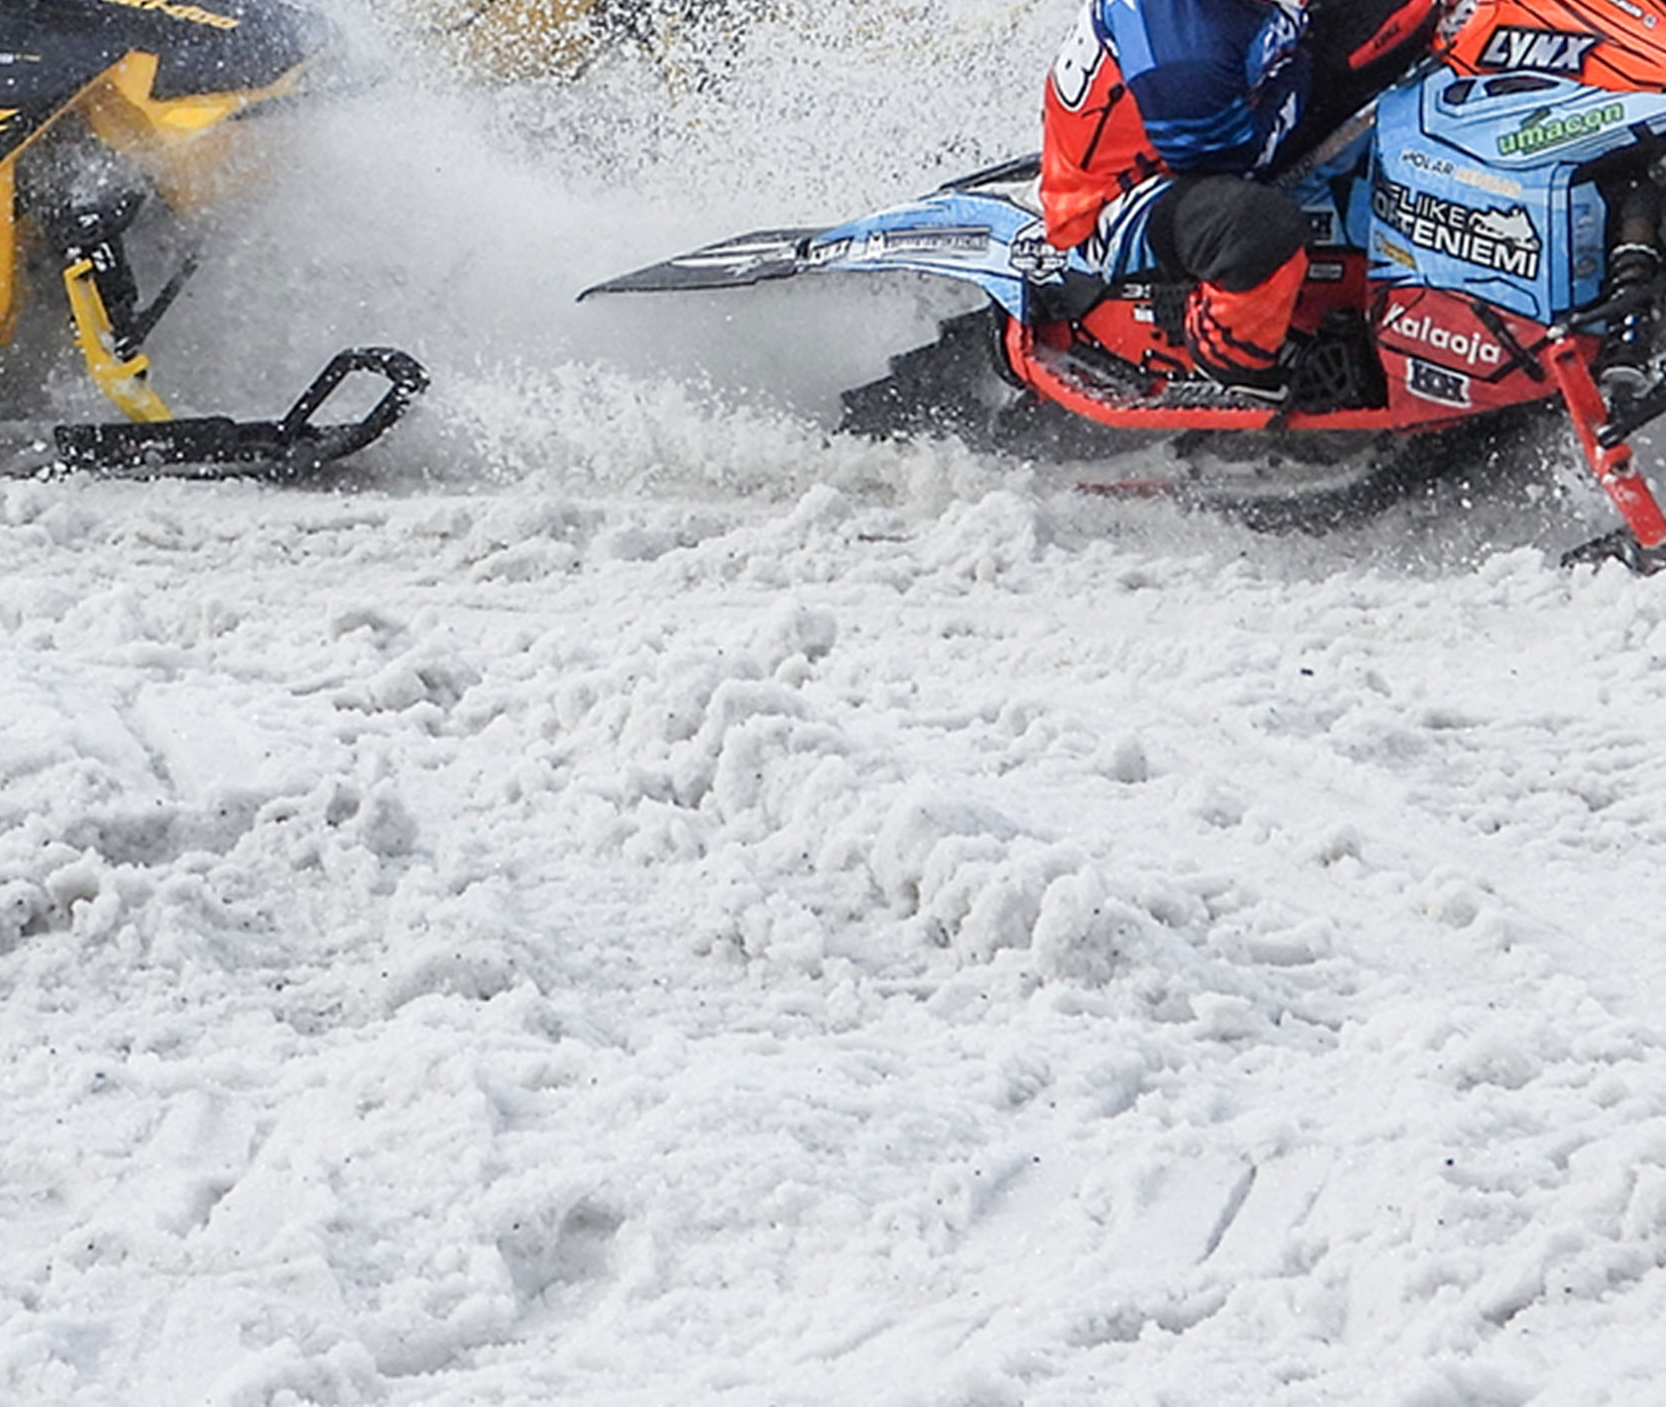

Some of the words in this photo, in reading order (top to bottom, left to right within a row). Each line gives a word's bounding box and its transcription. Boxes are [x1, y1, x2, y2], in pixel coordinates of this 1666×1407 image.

[1482, 30, 1596, 69] LYNX
[1497, 102, 1624, 156] umacon
[1382, 302, 1502, 365] Kalaoja
